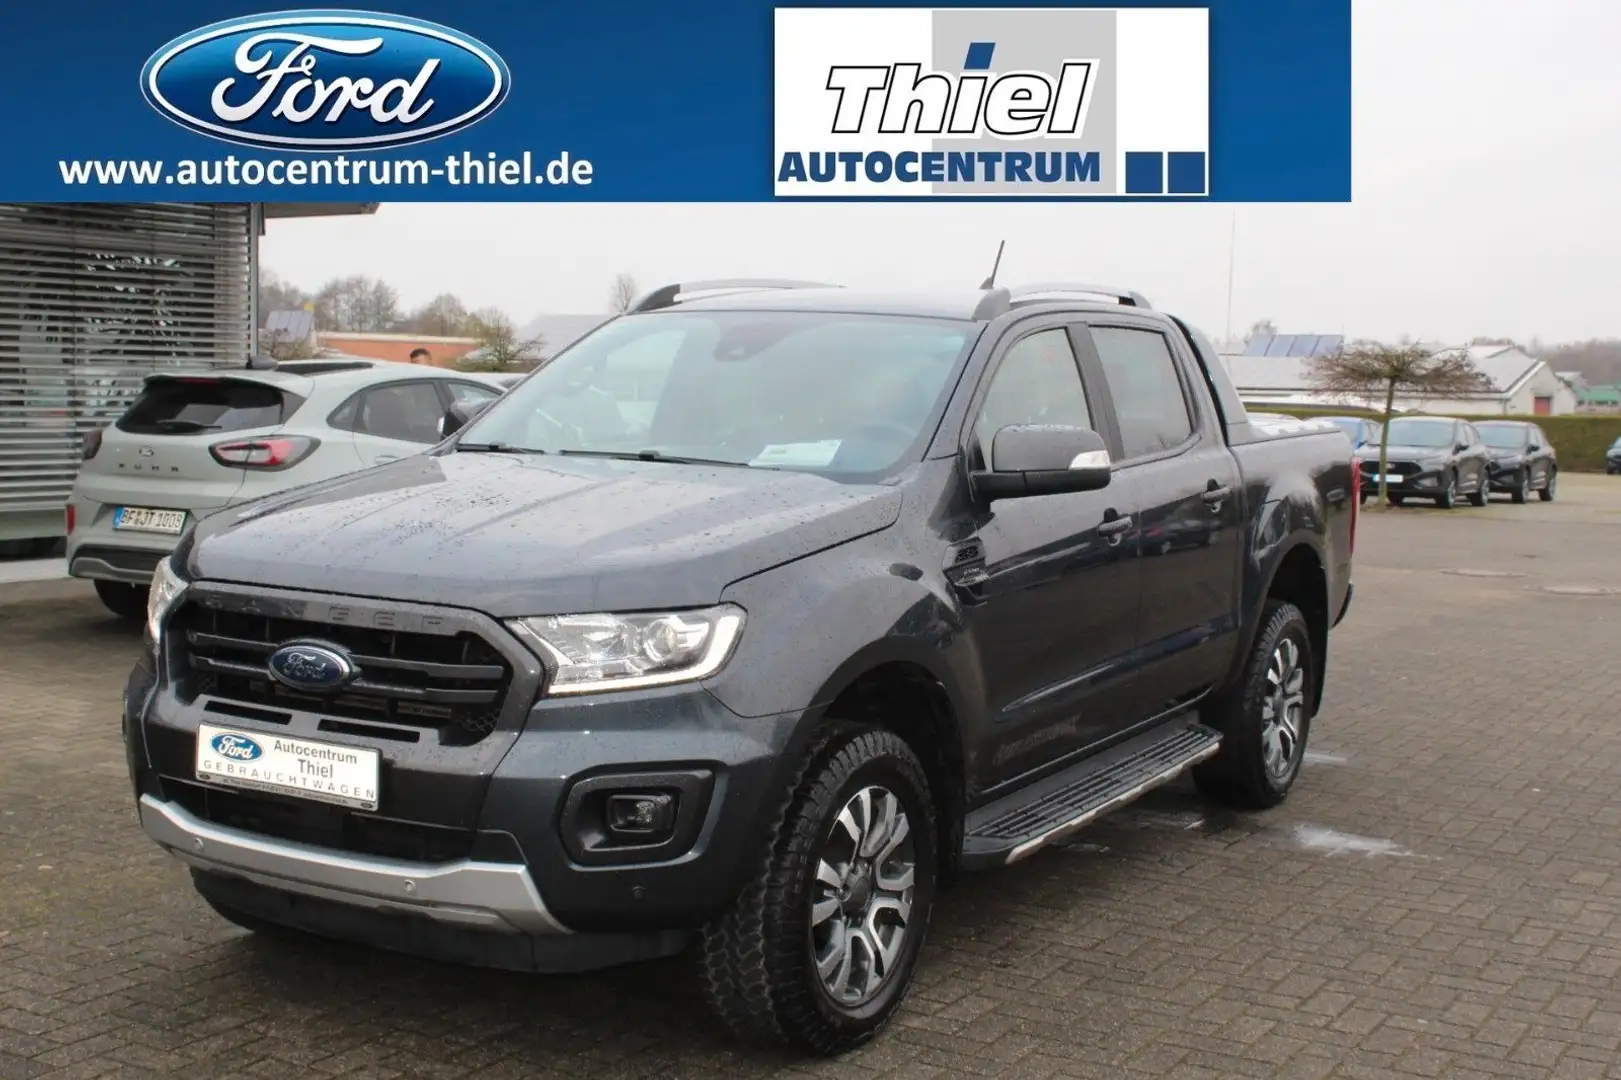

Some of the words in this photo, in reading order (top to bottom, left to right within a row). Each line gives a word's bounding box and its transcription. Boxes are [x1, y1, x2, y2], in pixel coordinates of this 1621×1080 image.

[283, 652, 327, 679] Ford
[218, 735, 255, 760] Ford
[274, 740, 358, 764] Autocentrum
[203, 760, 375, 799] GEBRAUCHTWAGEN
[297, 758, 334, 779] Thiel
